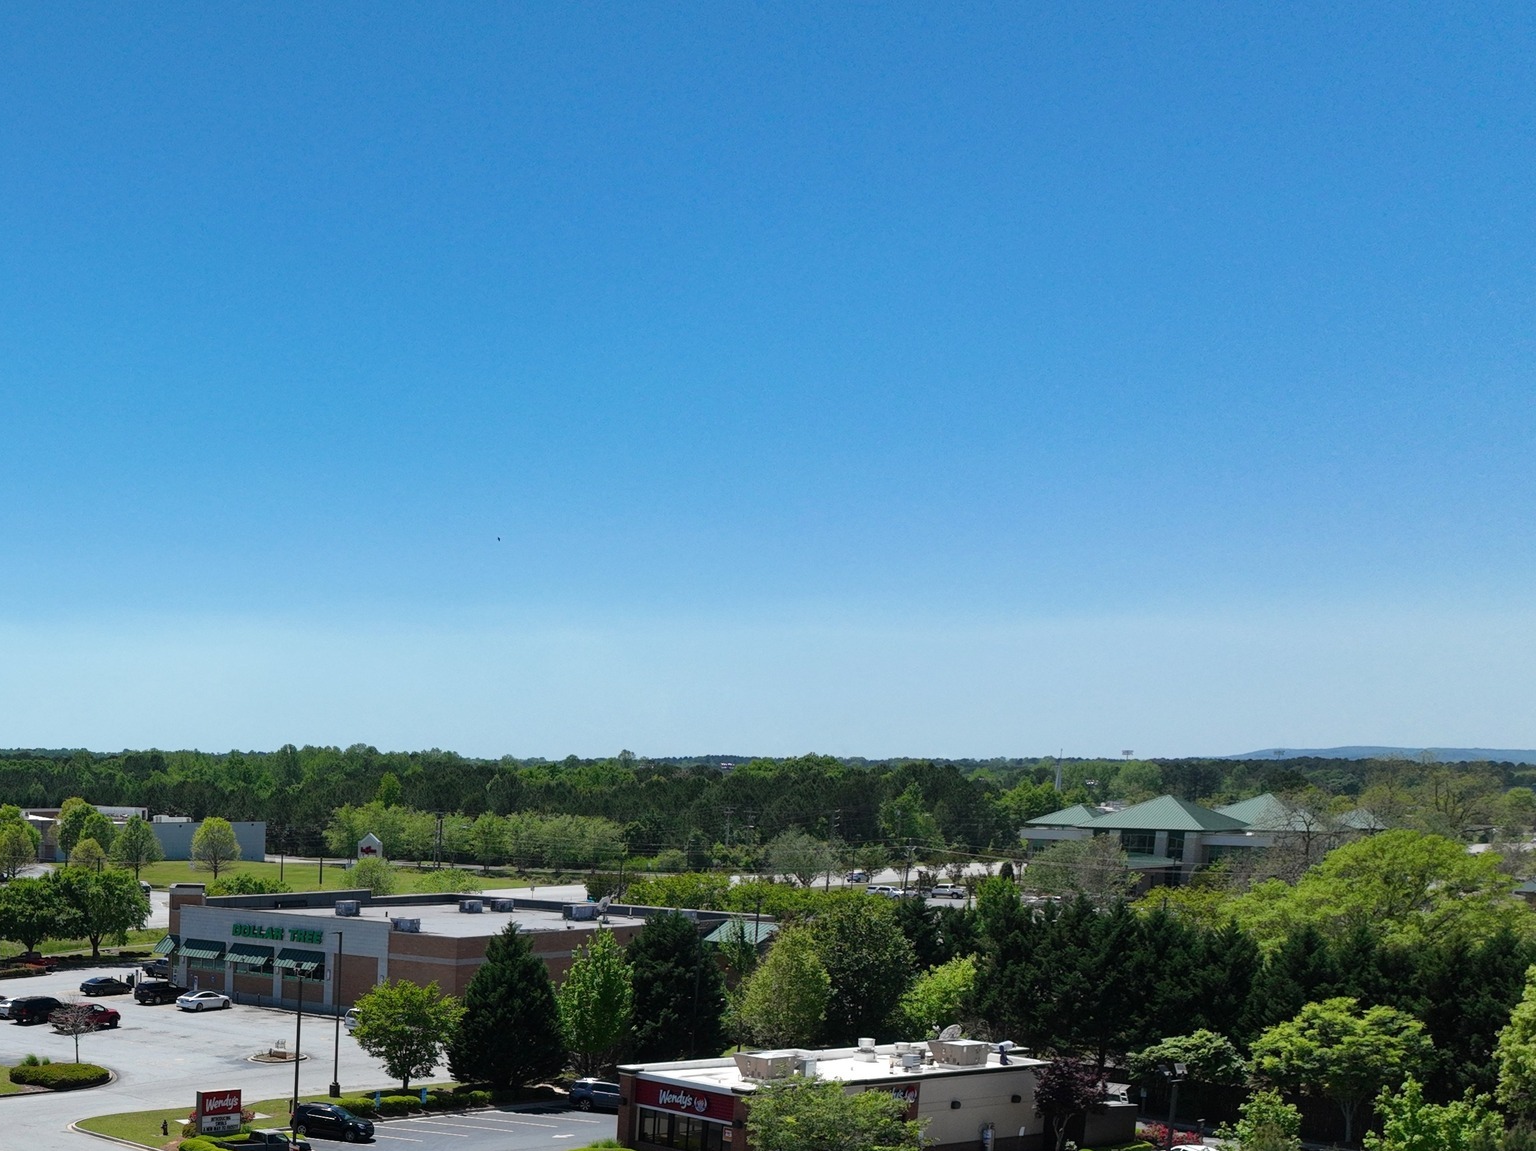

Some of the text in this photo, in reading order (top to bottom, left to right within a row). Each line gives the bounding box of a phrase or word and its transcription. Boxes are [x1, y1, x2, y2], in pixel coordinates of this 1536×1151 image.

[232, 924, 323, 944] DOLLAR TREE
[206, 1094, 239, 1112] Wendy's
[659, 1089, 693, 1109] Wendy's
